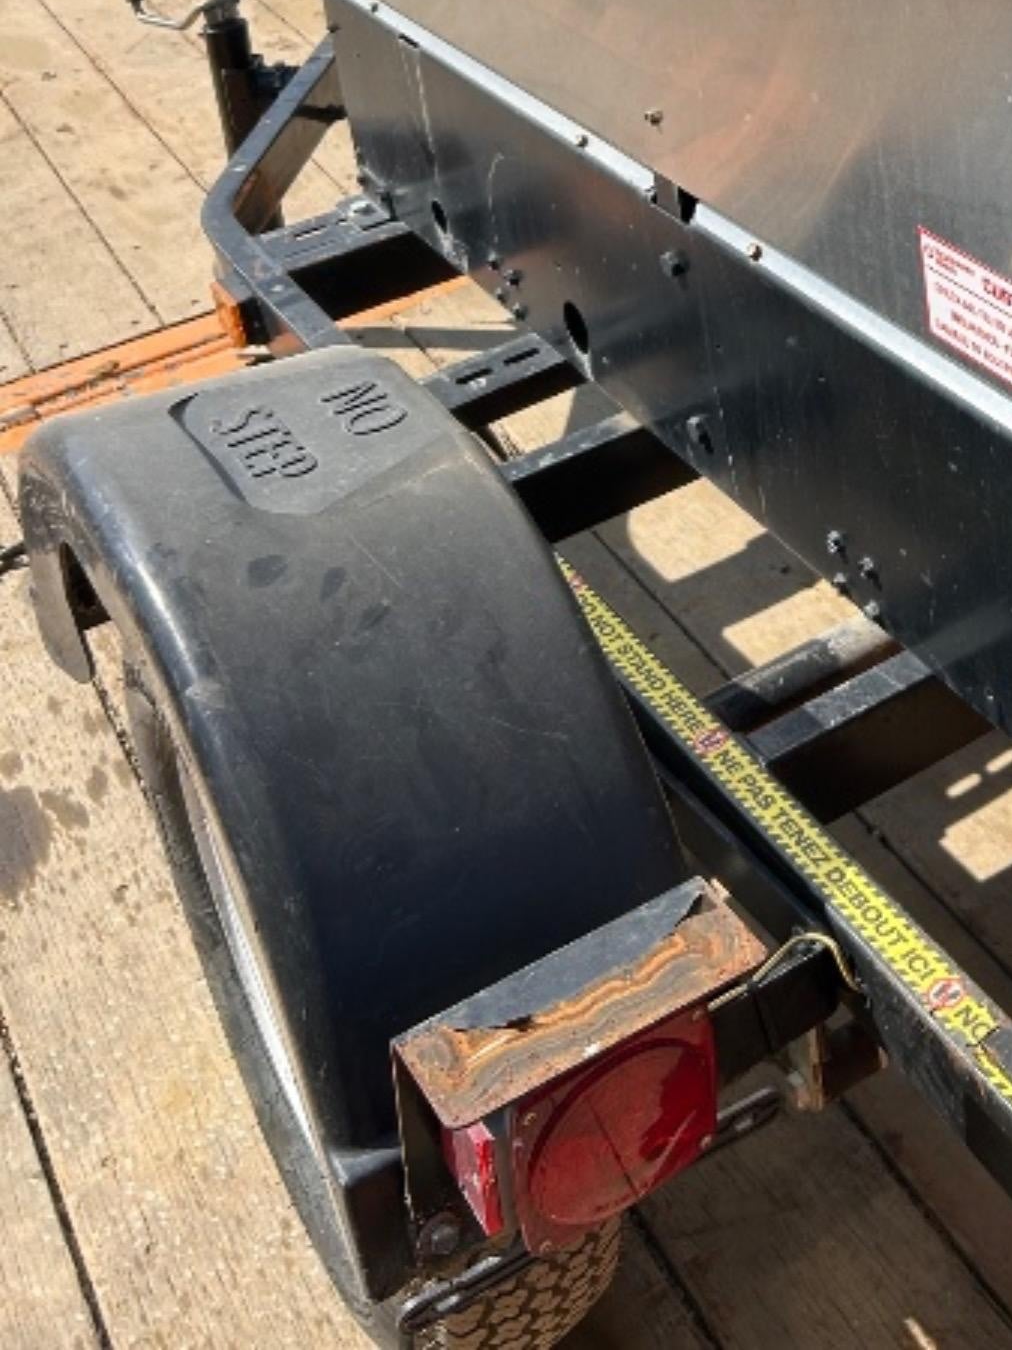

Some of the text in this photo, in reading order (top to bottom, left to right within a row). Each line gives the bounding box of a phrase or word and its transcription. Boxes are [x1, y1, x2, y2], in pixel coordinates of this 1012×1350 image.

[209, 406, 319, 479] STEP
[320, 380, 409, 436] NO
[713, 749, 937, 981] NE PAS TENEZ DEBOUT ICI
